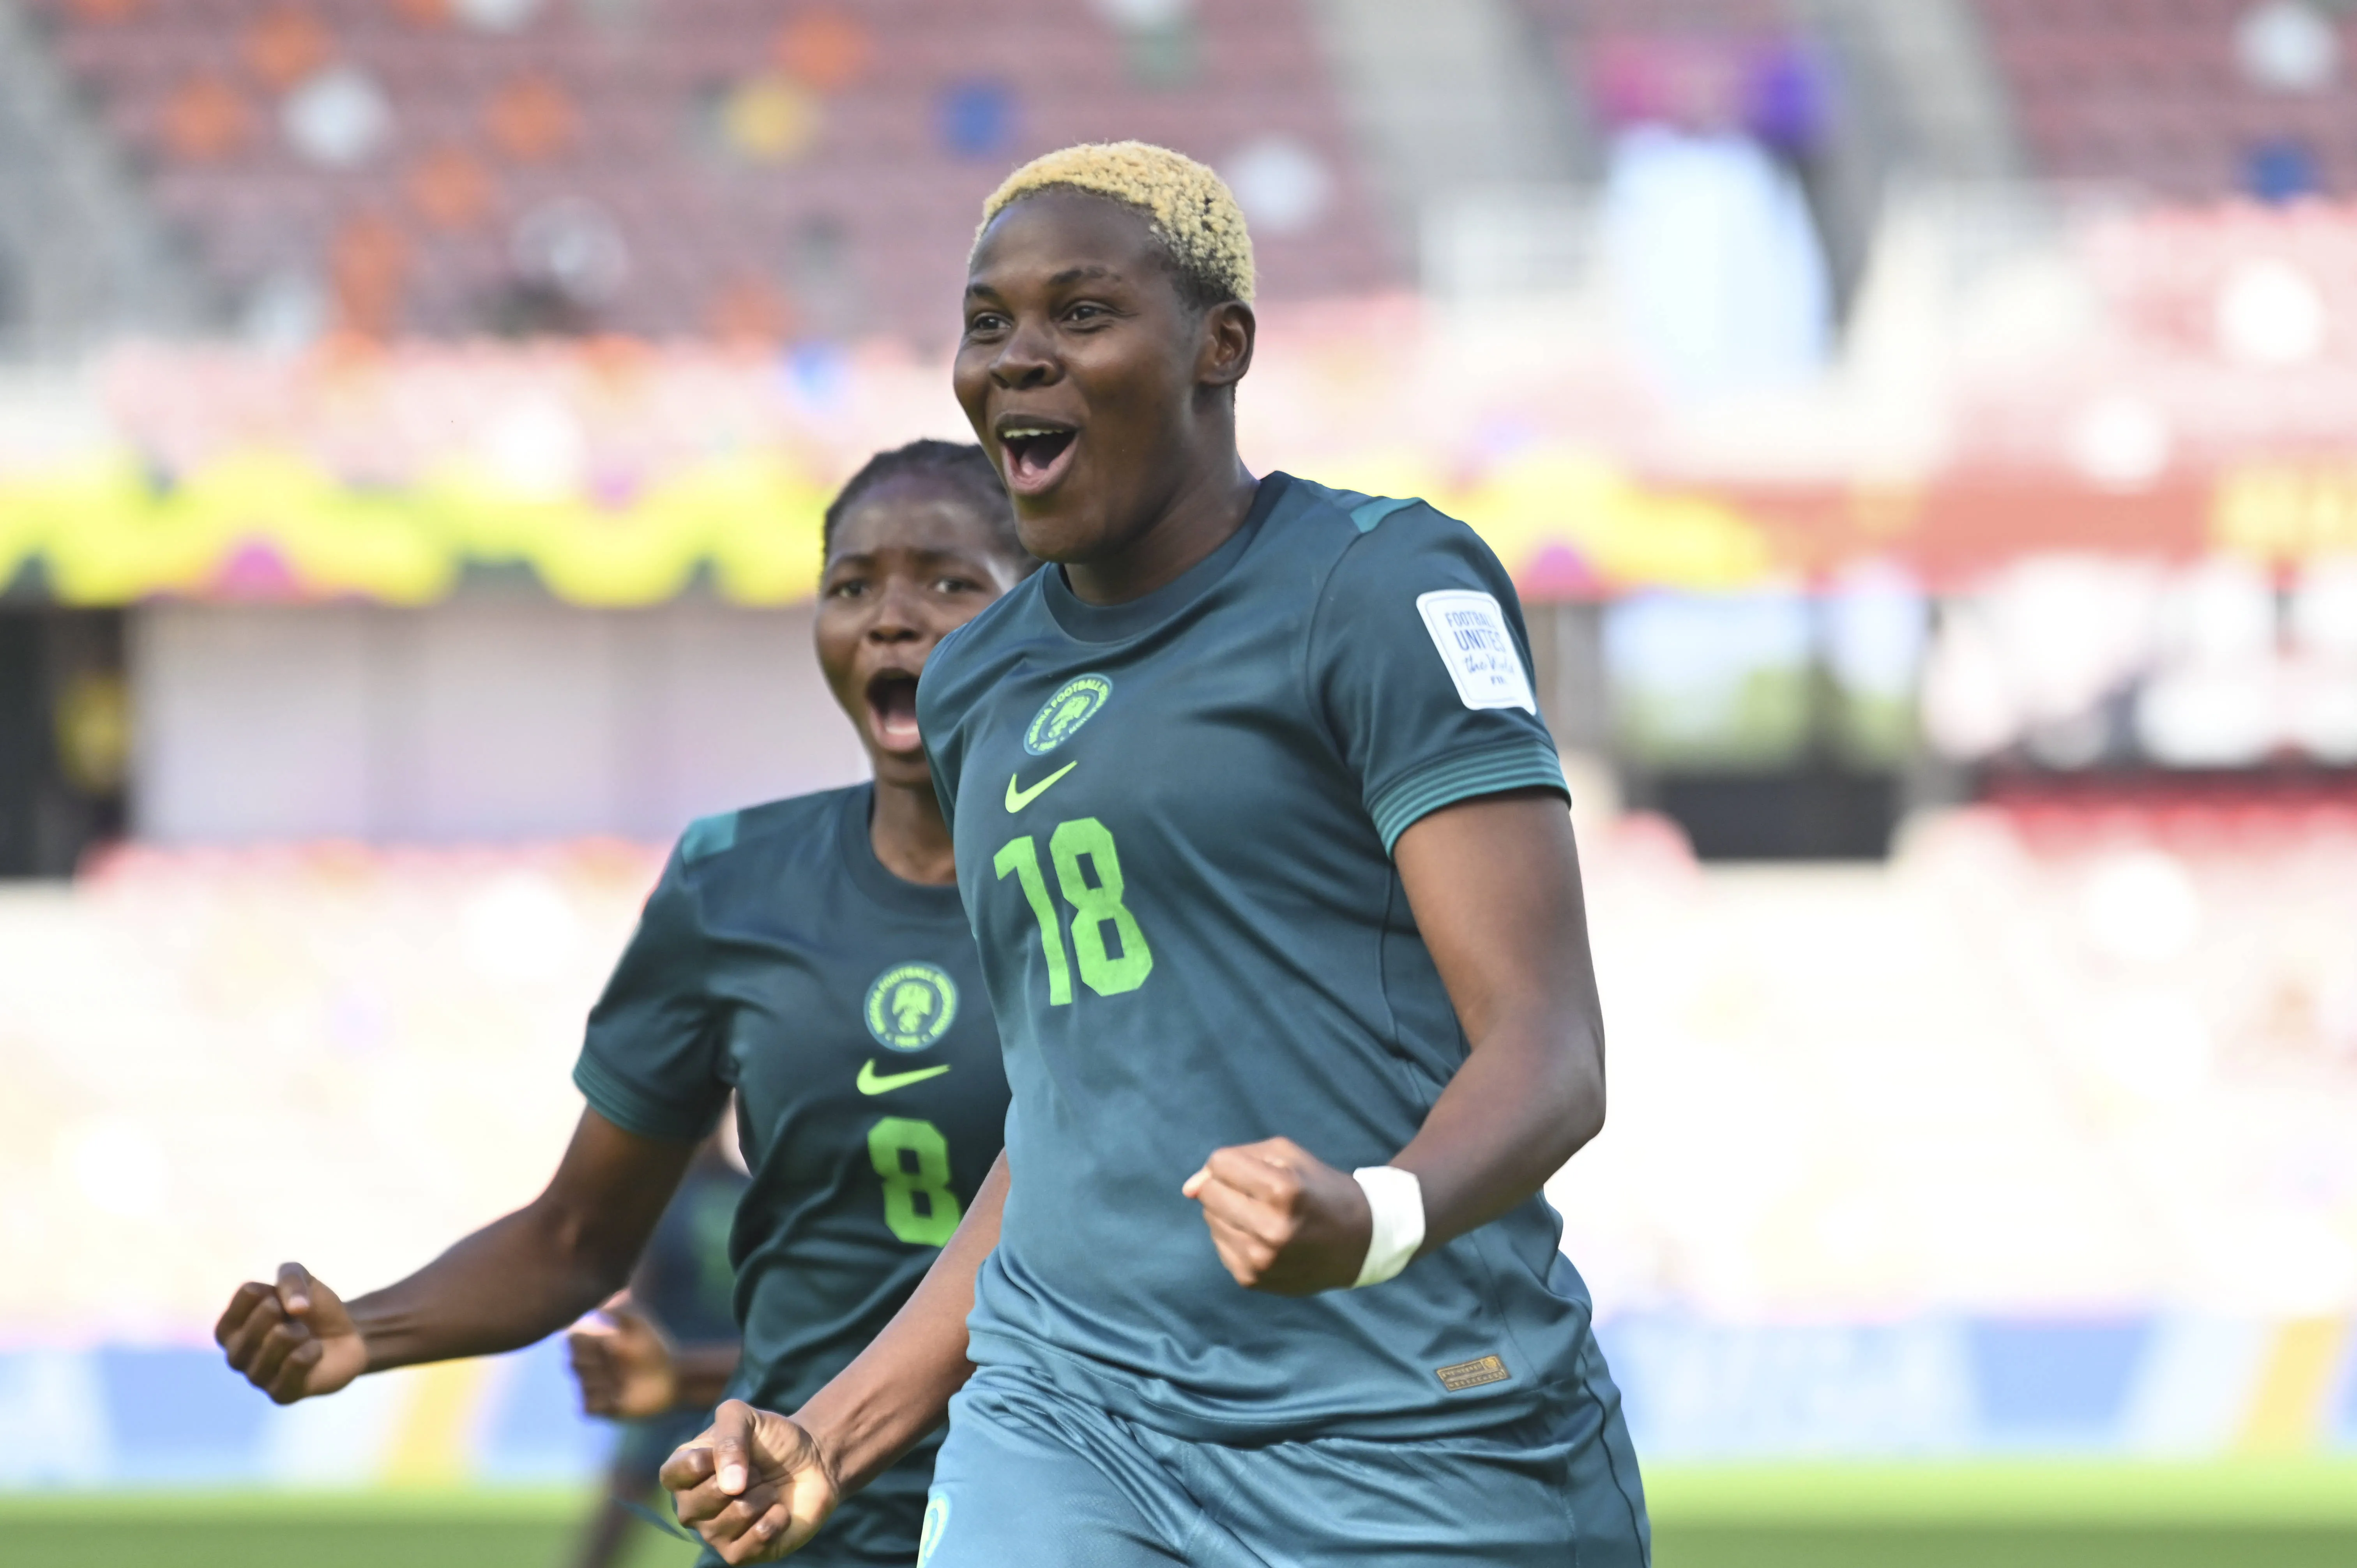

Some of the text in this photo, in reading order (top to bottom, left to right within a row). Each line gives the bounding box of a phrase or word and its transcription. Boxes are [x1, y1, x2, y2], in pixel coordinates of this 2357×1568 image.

[1444, 611, 1497, 629] FOOTBALL
[1453, 629, 1506, 653] UNITES
[993, 816, 1153, 1006] 18
[867, 1116, 961, 1248] 8
